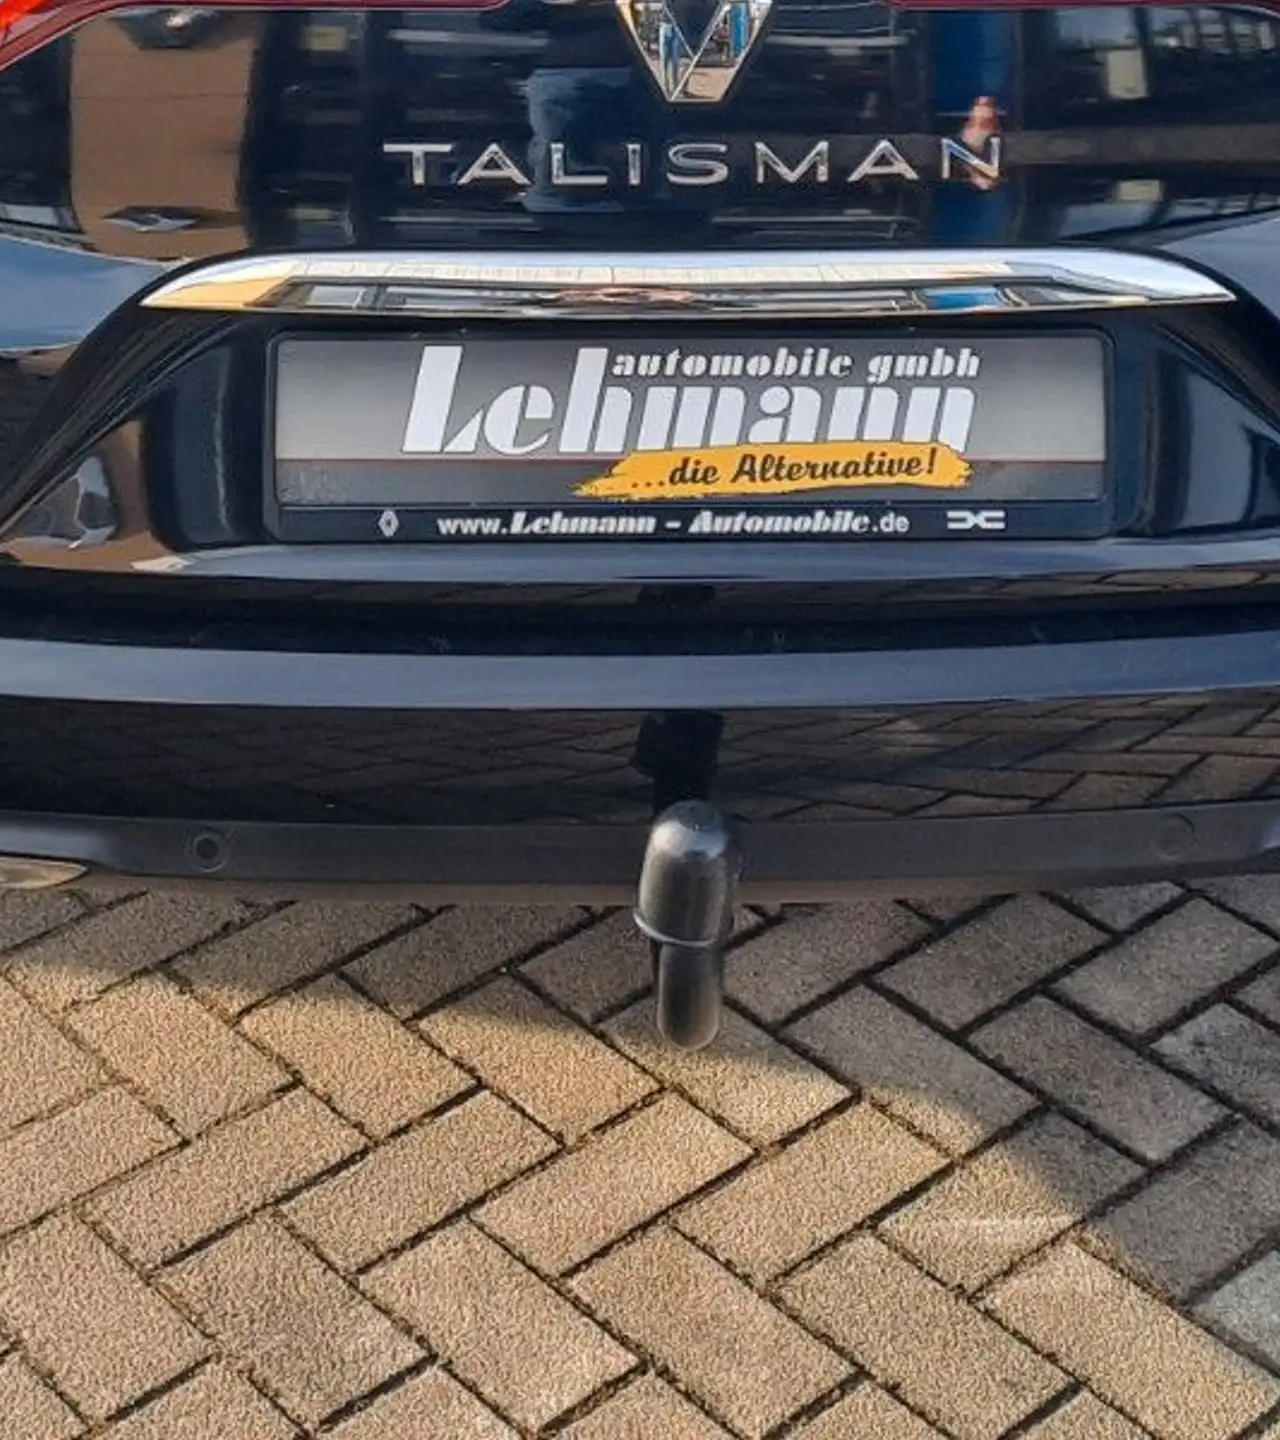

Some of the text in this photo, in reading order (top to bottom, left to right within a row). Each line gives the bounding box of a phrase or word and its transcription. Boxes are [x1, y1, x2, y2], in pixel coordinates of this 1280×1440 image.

[382, 138, 1002, 186] TALISMAN
[612, 347, 981, 385] automobile gmbh
[402, 345, 976, 454] Lehmann
[730, 446, 938, 484] Alternative!
[436, 510, 658, 536] www.Lehmann
[688, 510, 910, 534] Automobile.de
